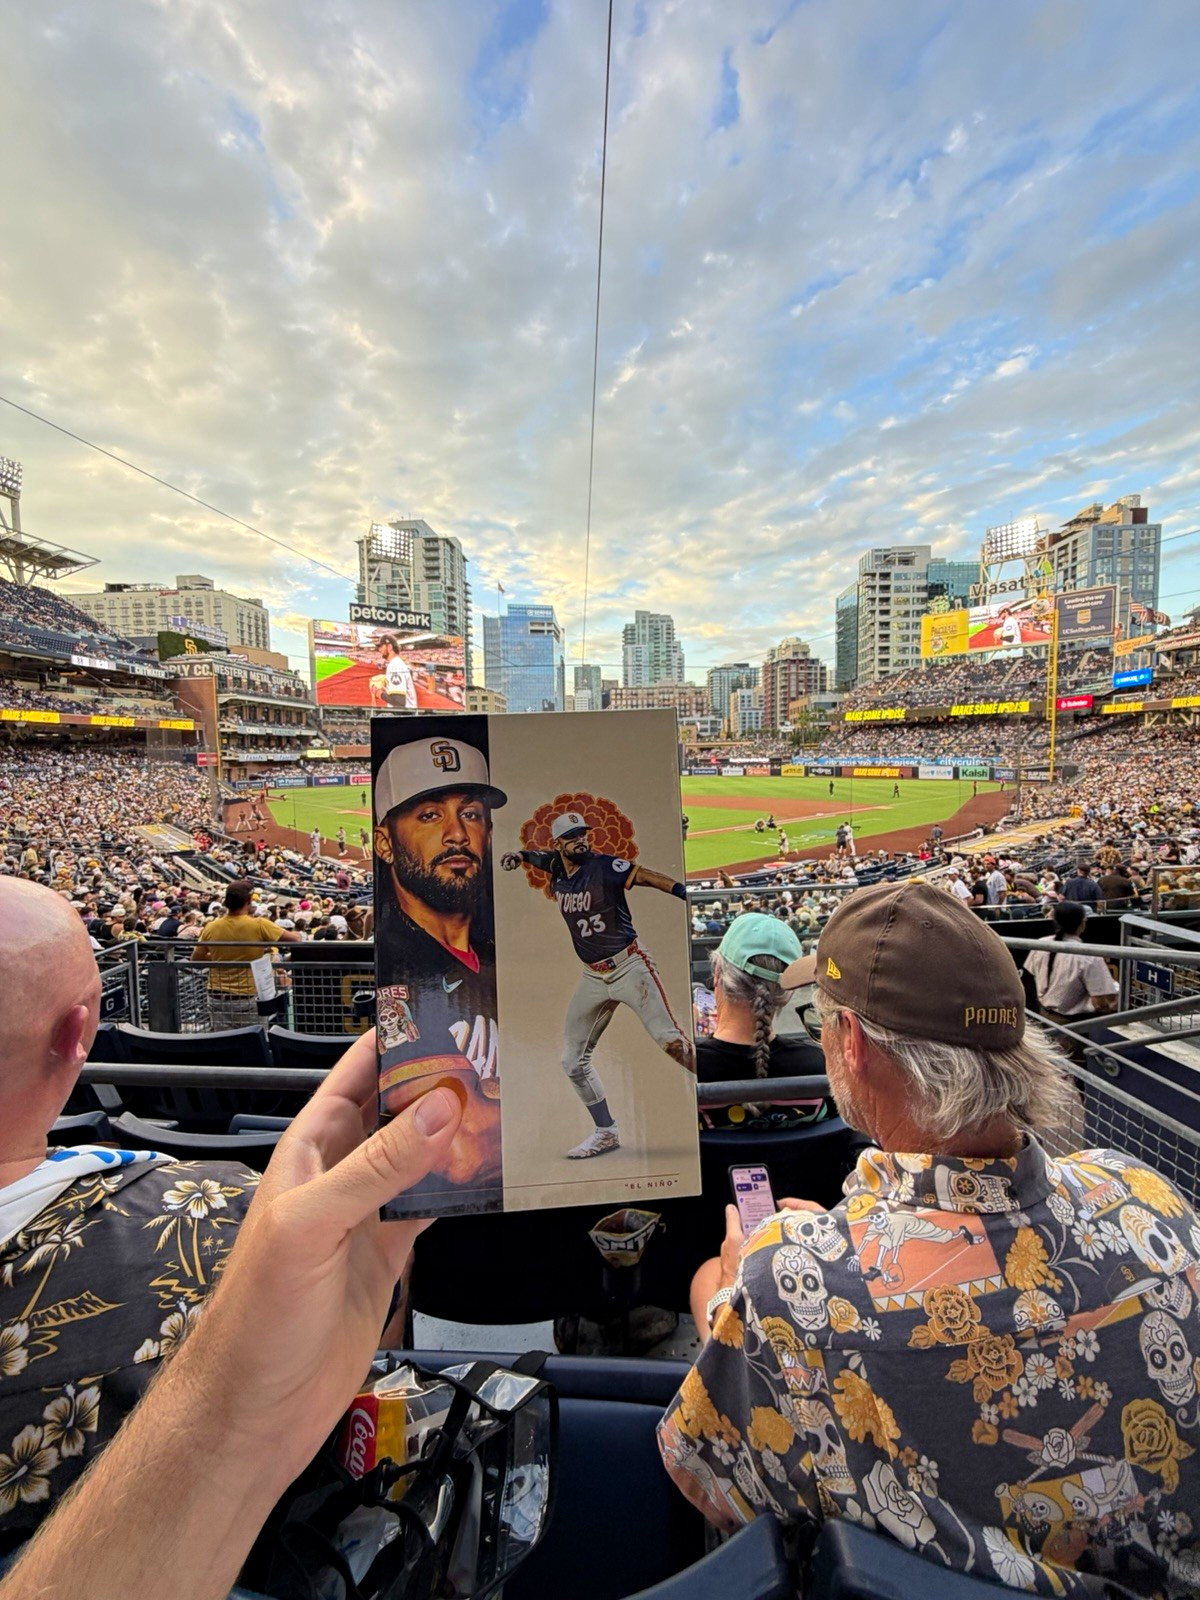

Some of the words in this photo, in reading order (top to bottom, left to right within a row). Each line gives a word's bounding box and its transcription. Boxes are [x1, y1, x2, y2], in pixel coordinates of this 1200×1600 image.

[972, 576, 1027, 596] Viasat
[350, 605, 396, 622] petco
[397, 612, 430, 627] park
[193, 663, 213, 677] CO.
[214, 662, 248, 680] WESTERN
[271, 675, 294, 689] SUPPLY
[845, 711, 863, 721] MAKE
[863, 709, 881, 720] SOME
[951, 705, 975, 716] MAKE
[974, 703, 998, 715] SOME
[576, 913, 606, 938] 23
[1148, 970, 1158, 983] H
[106, 998, 115, 1011] G
[965, 1006, 1018, 1029] PADRES
